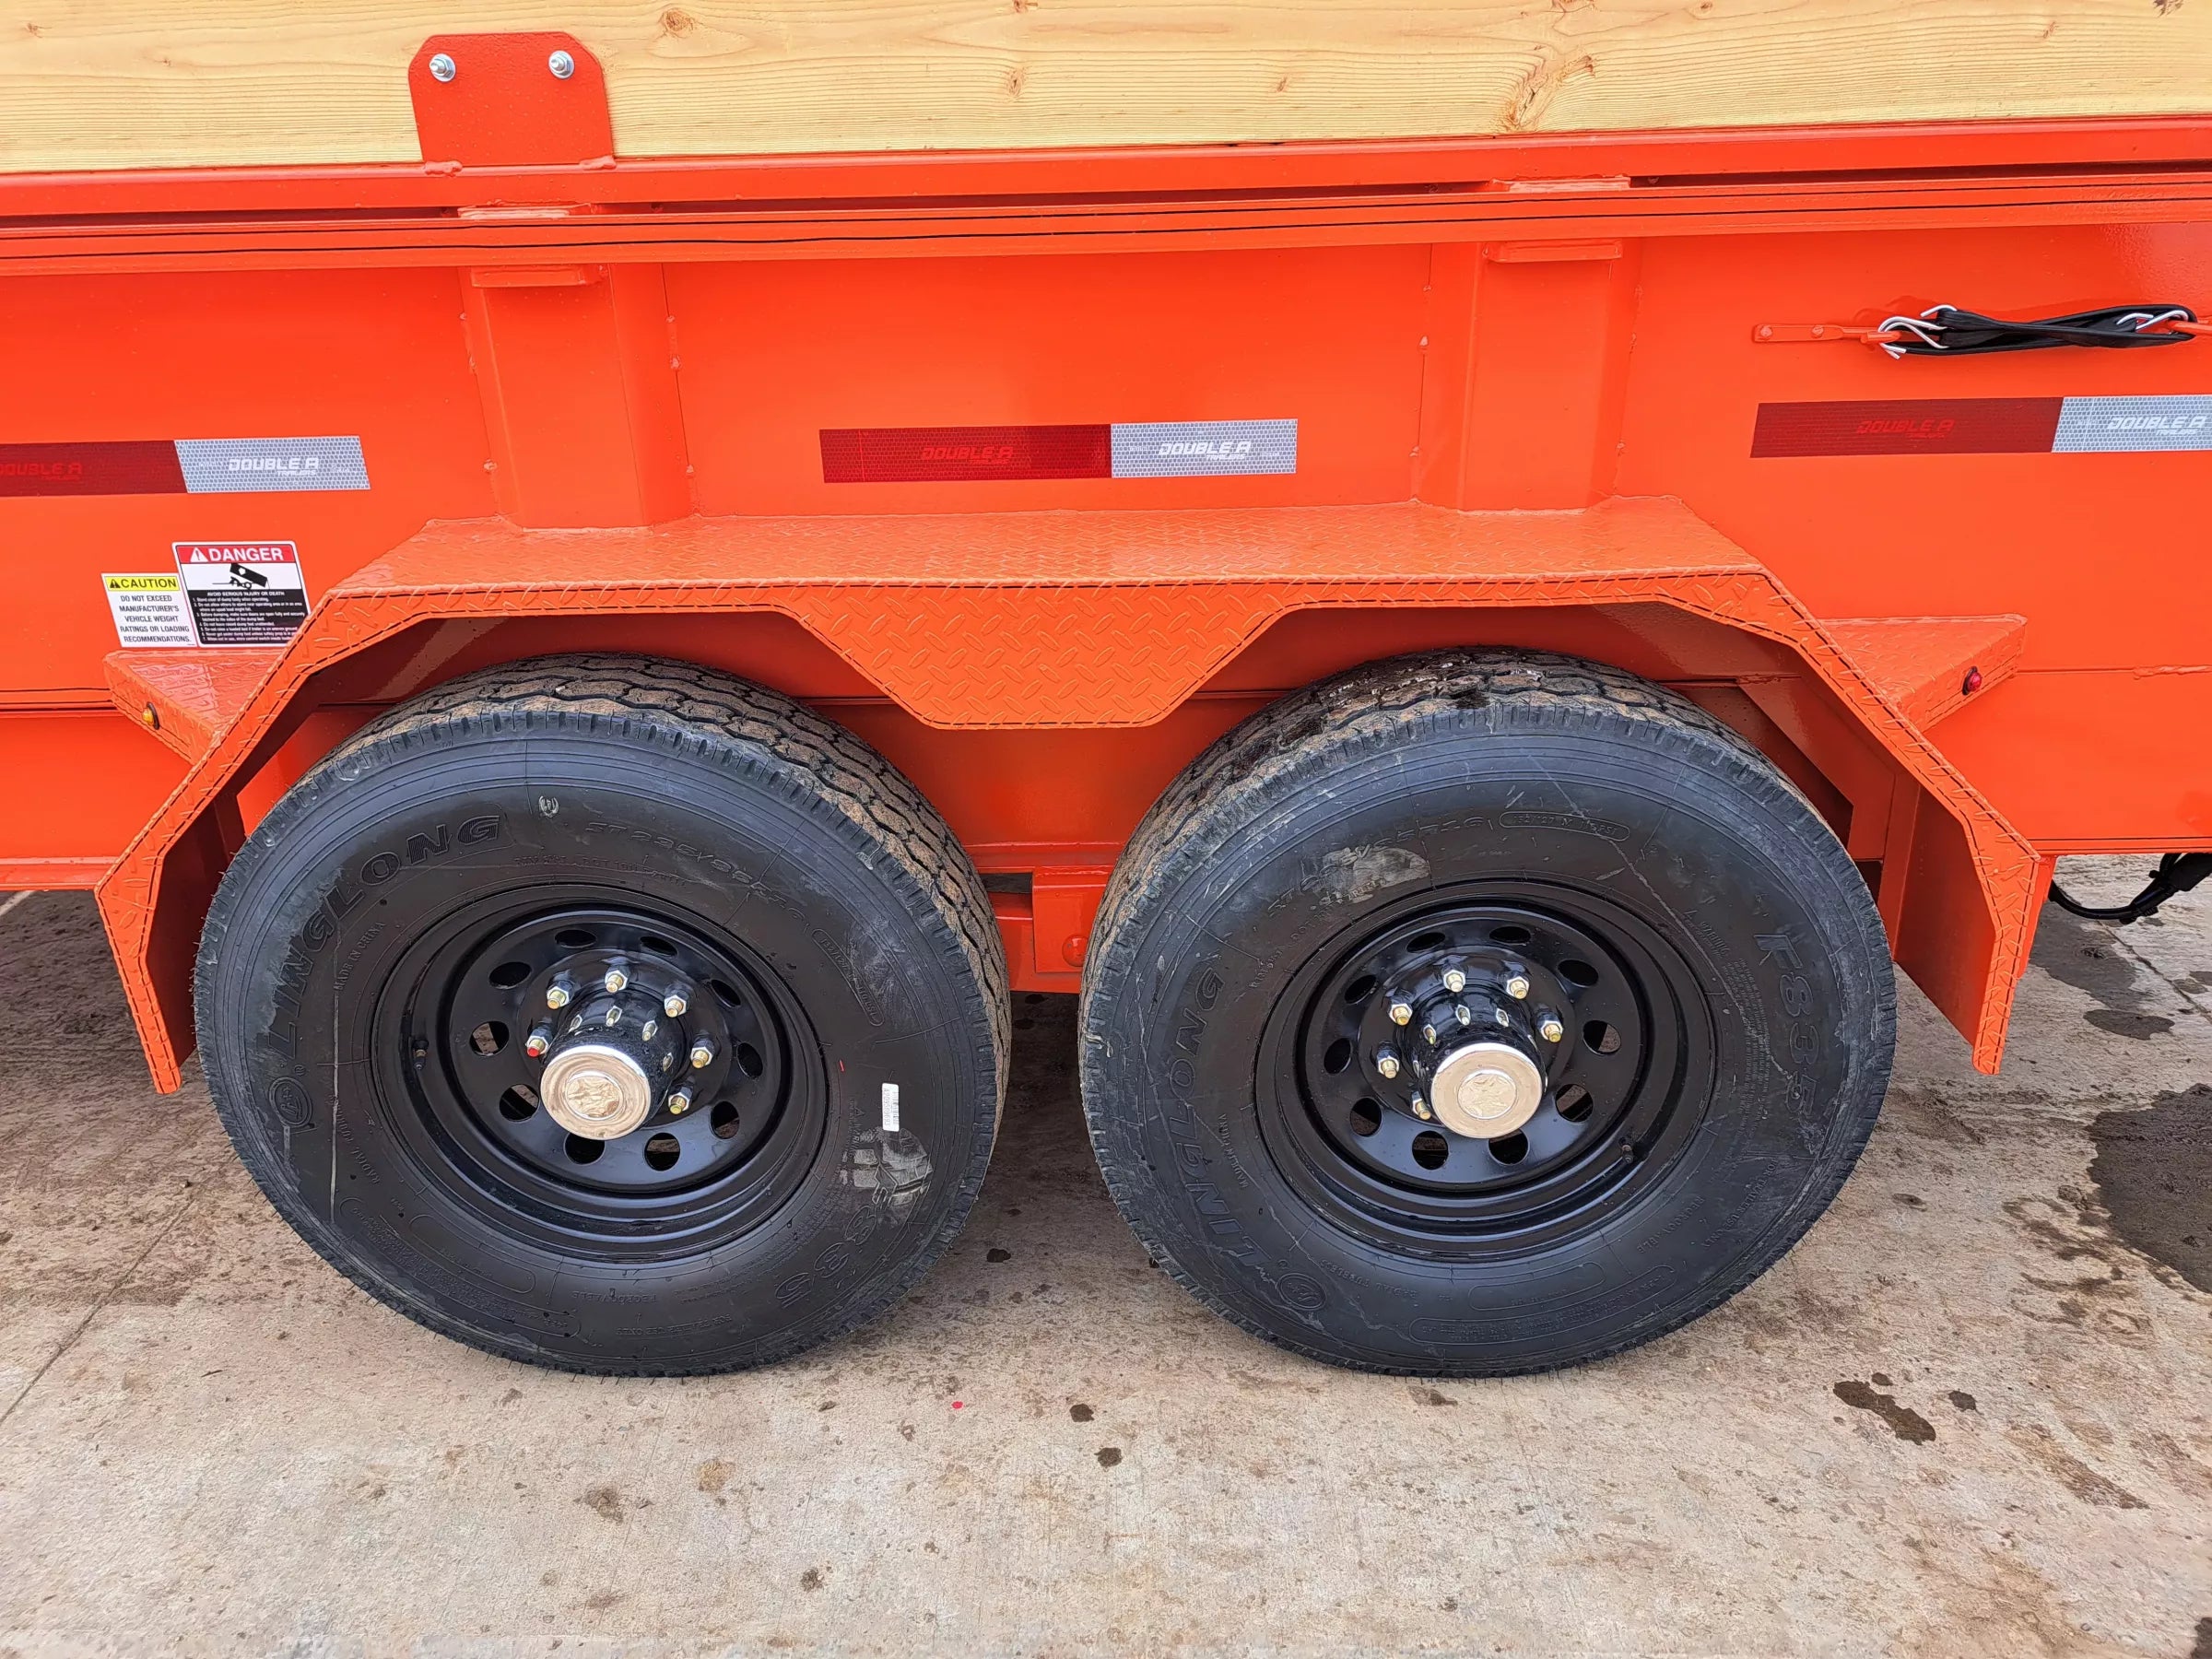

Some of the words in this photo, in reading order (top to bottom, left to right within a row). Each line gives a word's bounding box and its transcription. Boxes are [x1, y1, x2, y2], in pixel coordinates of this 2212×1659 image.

[1857, 418, 1936, 434] DOUBLE
[1937, 418, 1955, 433] A
[2107, 416, 2189, 429] DOUBLE
[2189, 416, 2207, 429] A
[923, 446, 994, 460] DOUBLE
[998, 446, 1014, 459] A
[1159, 441, 1233, 455] DOUBLE
[1233, 441, 1252, 454] A
[228, 458, 301, 471] DOUBLE
[304, 457, 319, 470] A
[208, 547, 284, 562] DANGER
[121, 579, 177, 588] CAUTION
[266, 814, 500, 1059] LINGLONG
[1753, 932, 1822, 1116] F835
[1167, 968, 1272, 1270] LINGLONG
